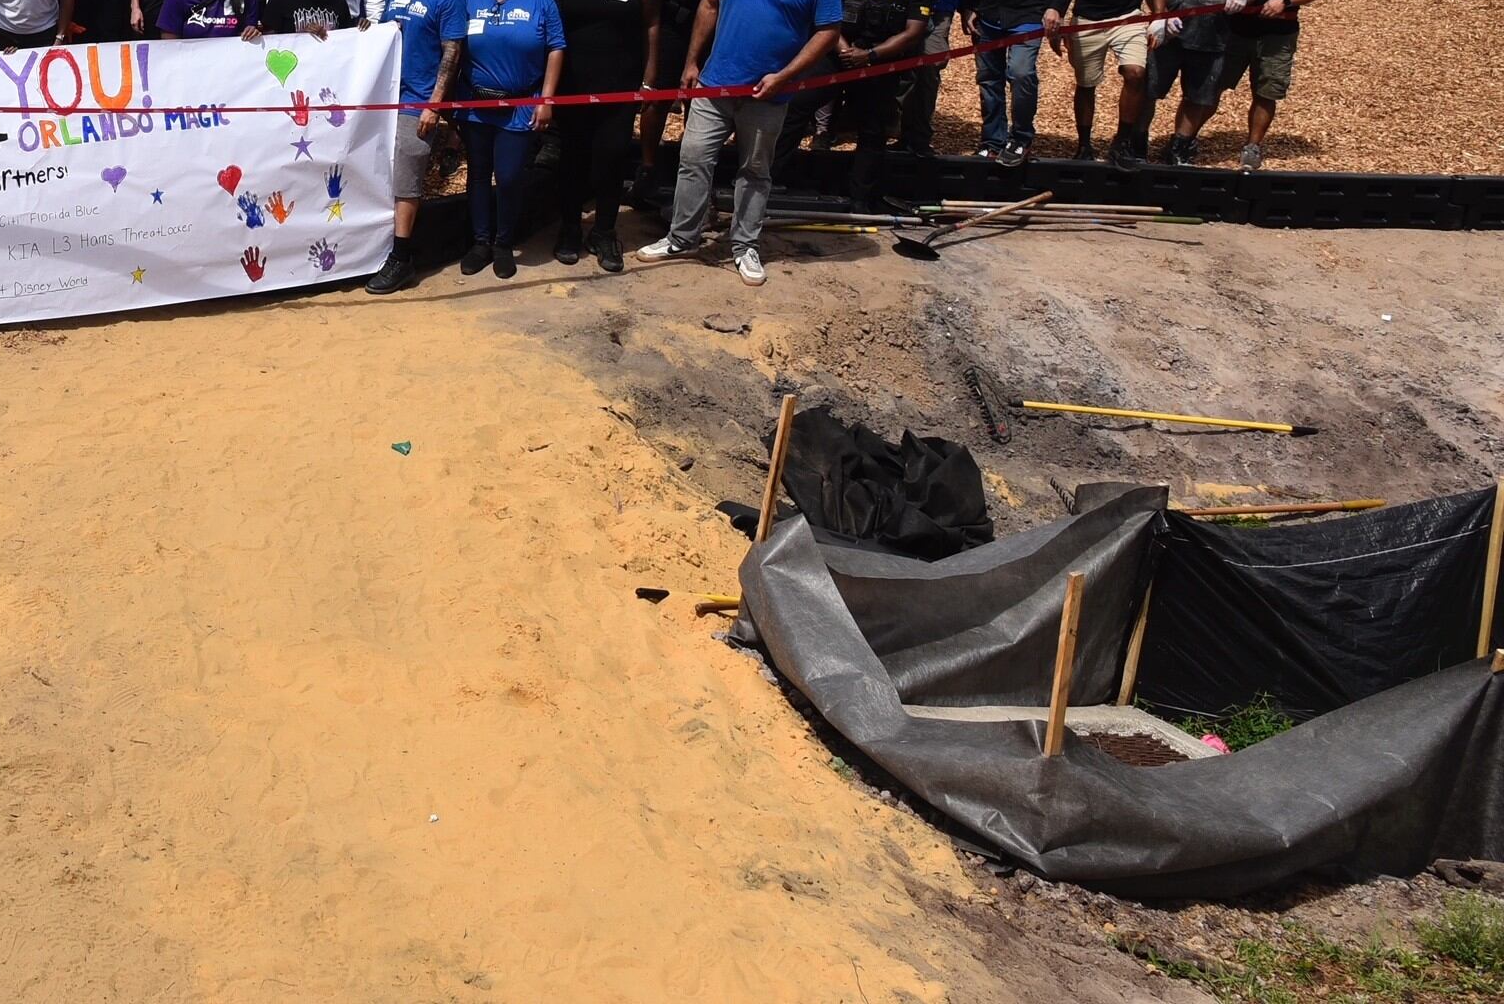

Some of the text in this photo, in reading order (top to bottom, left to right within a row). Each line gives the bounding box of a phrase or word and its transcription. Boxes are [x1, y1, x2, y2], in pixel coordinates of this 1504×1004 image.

[17, 111, 154, 152] ORLANDO
[164, 102, 231, 131] MAGIC
[30, 209, 71, 225] Florida
[75, 204, 100, 216] Blue
[8, 242, 42, 261] KIA
[52, 235, 72, 254] L3
[13, 281, 52, 295] Disney
[58, 275, 88, 288] World
